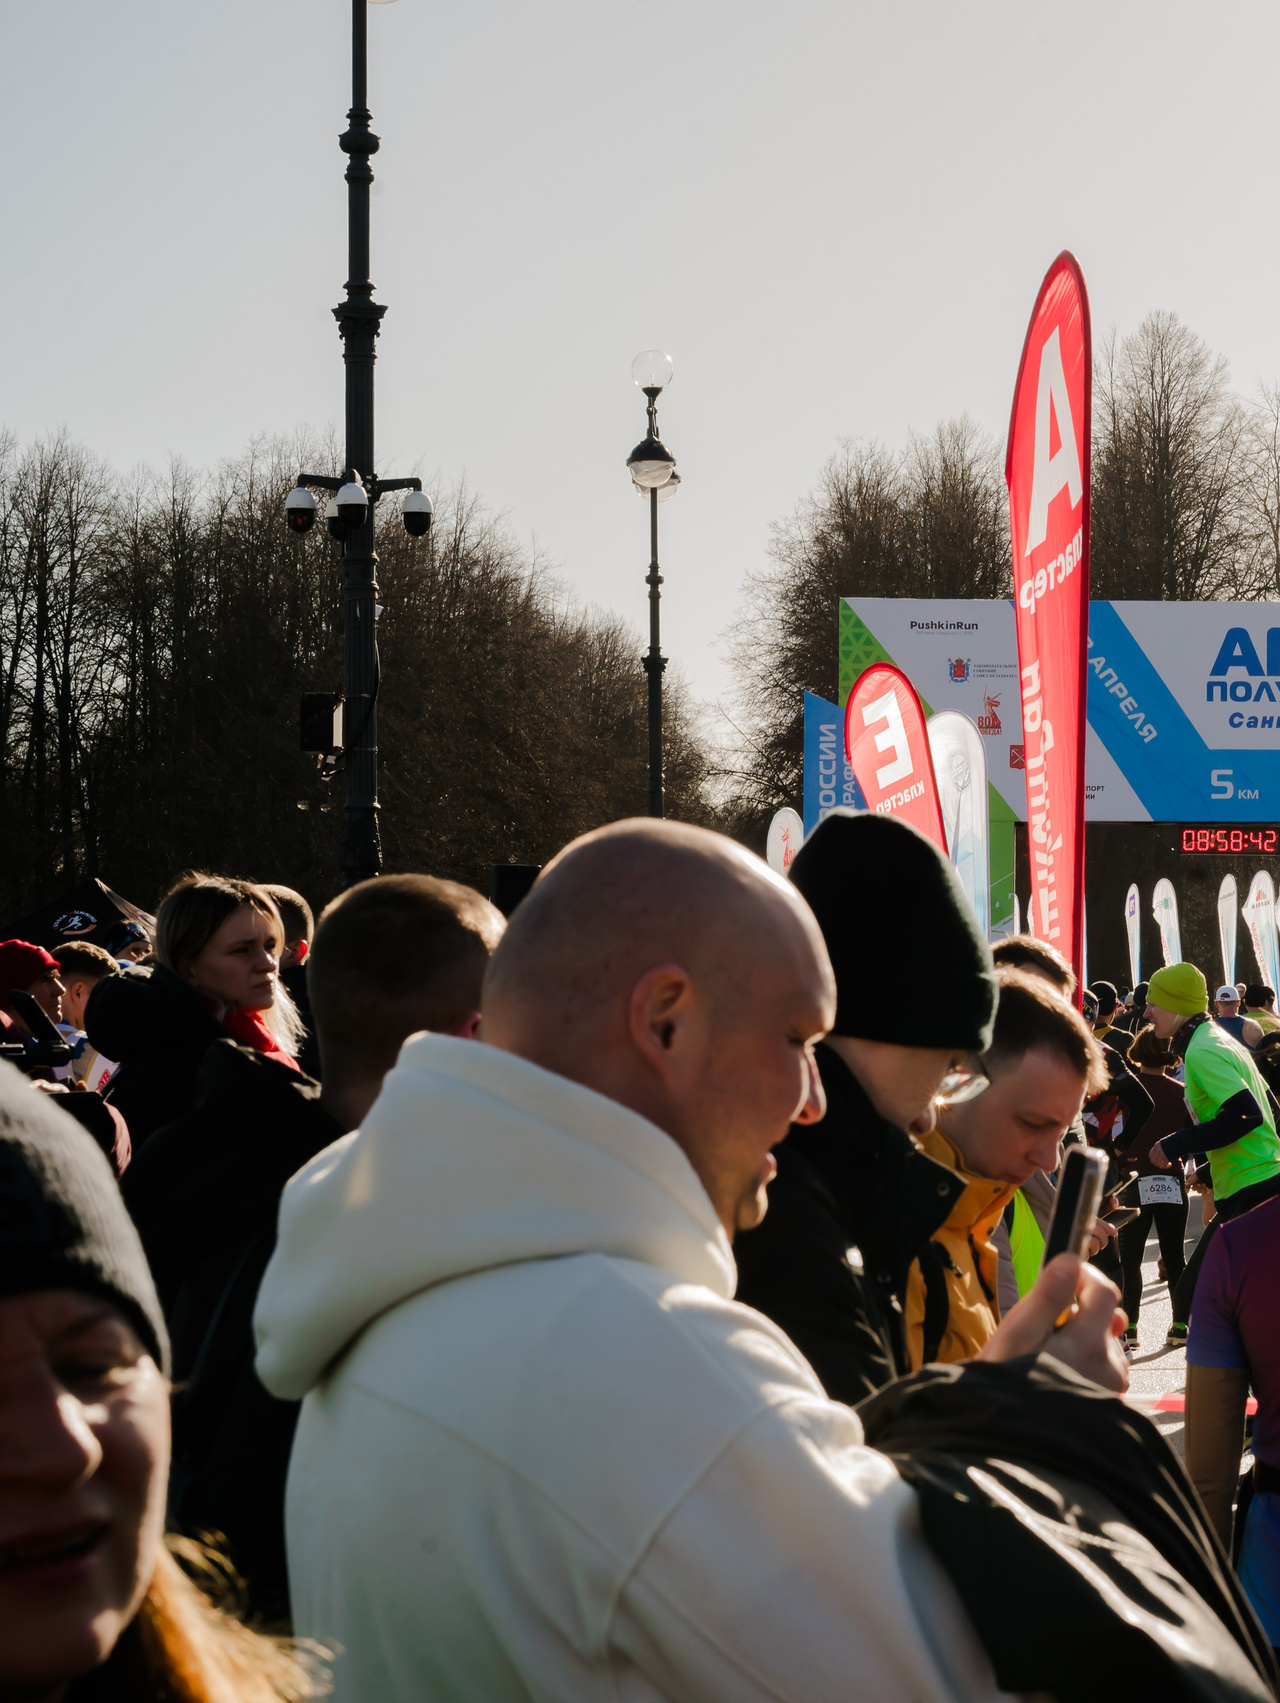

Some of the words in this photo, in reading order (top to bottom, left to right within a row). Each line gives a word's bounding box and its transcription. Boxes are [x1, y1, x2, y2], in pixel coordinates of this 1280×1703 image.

[910, 620, 978, 630] PushkinRun
[1087, 655, 1159, 744] АПРЕЛЯ
[1210, 769, 1234, 800] 5
[1238, 787, 1260, 800] КМ
[1182, 829, 1278, 853] 08:58:42
[1149, 1183, 1173, 1193] 6286
